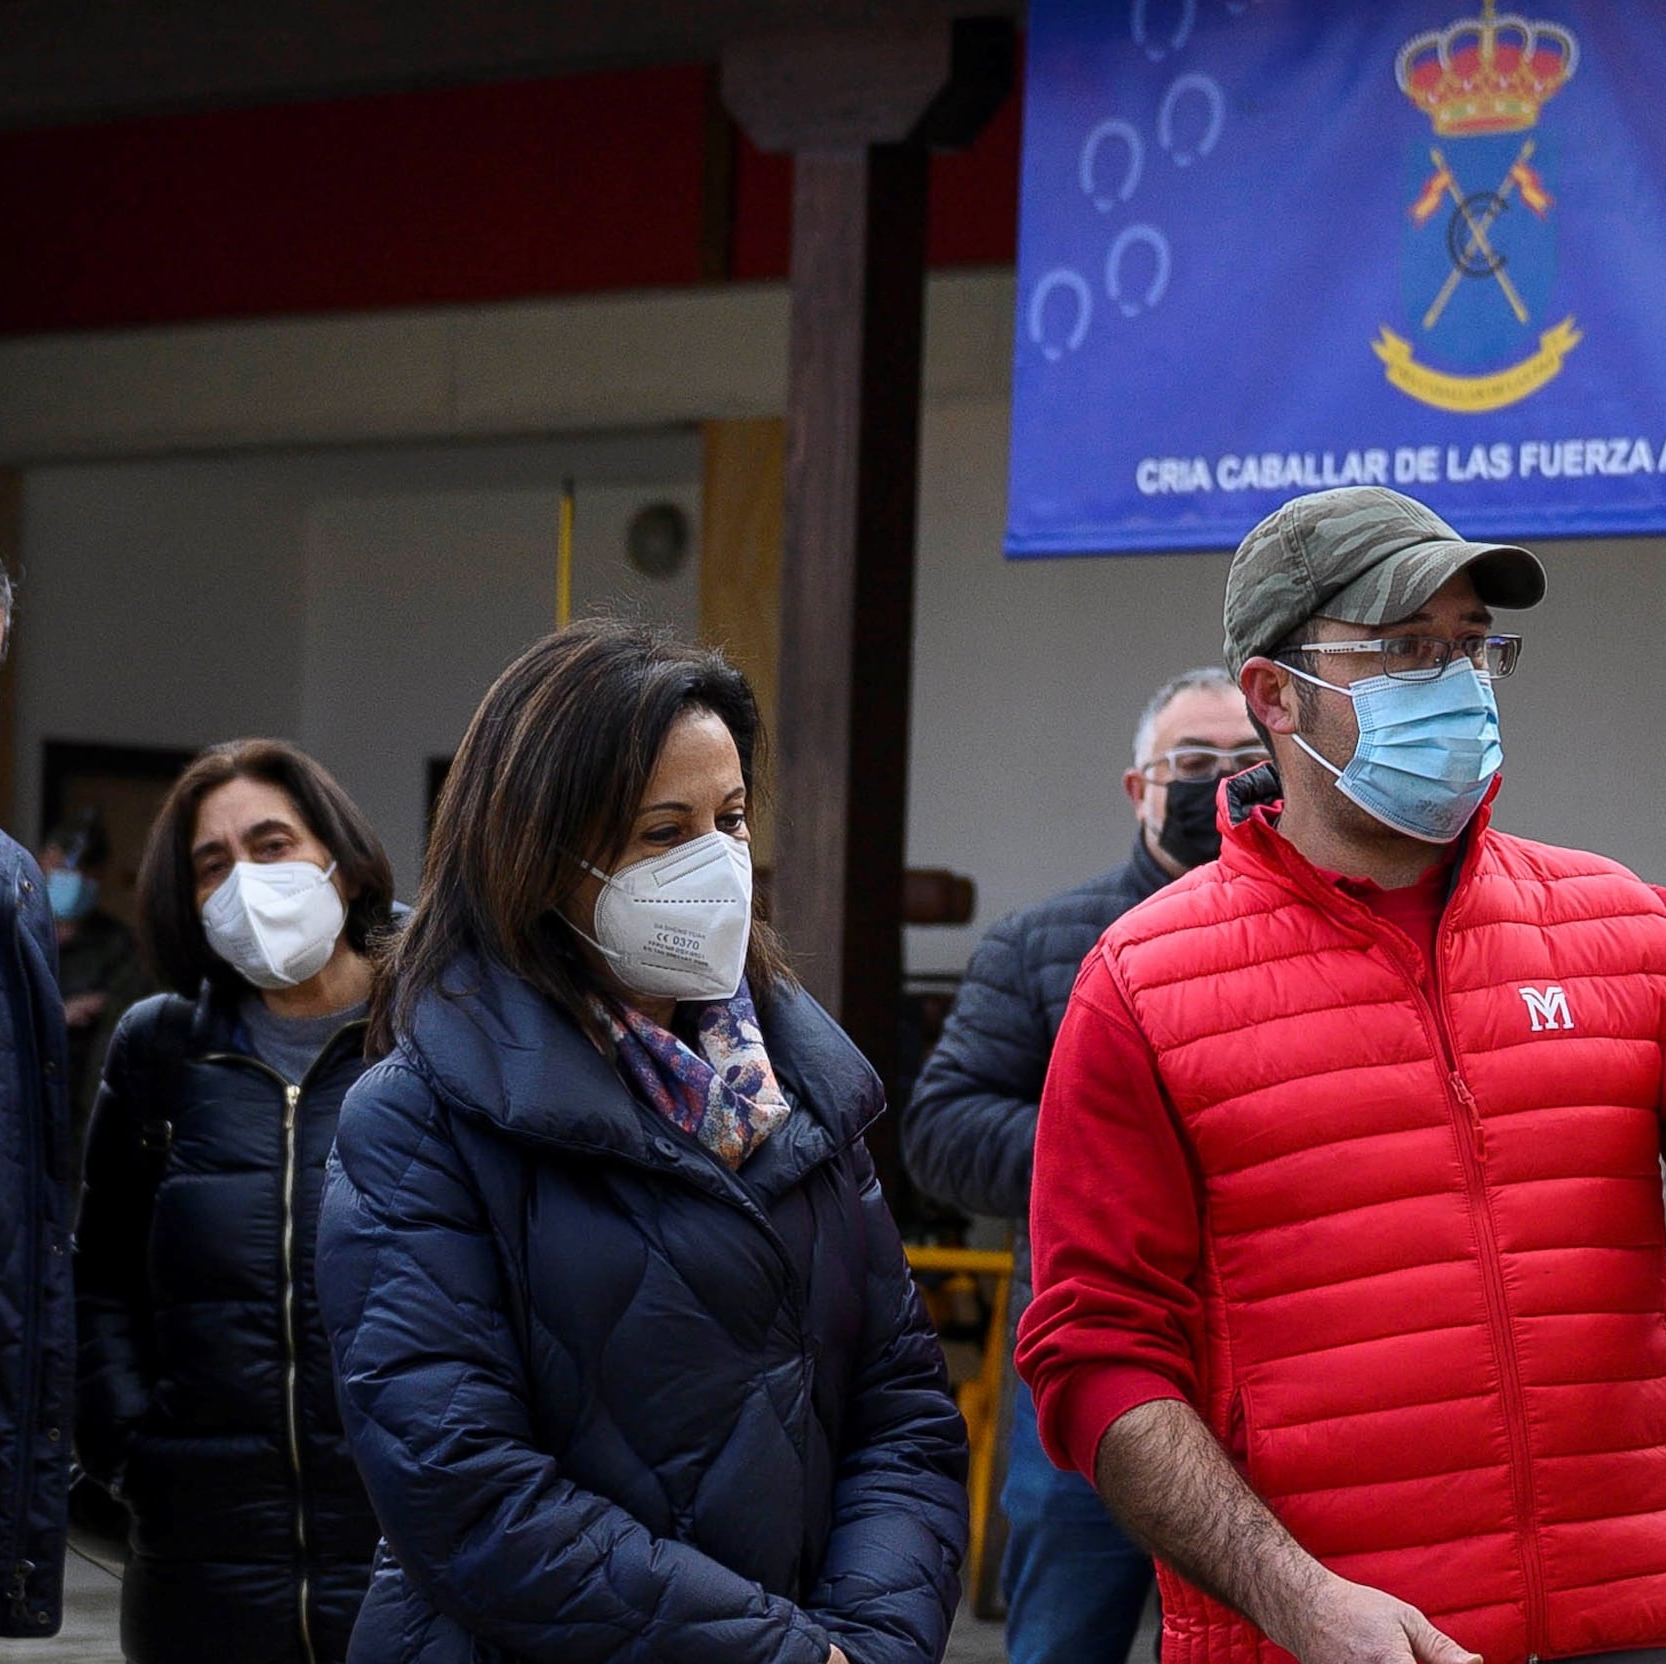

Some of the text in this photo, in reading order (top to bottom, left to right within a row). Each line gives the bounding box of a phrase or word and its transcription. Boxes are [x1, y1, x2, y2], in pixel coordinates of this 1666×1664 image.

[1136, 457, 1212, 494] CRIA
[1216, 450, 1389, 489] CABALLAR
[1394, 446, 1440, 484] DE
[1446, 441, 1512, 481] LAS
[1520, 438, 1653, 478] FUERZA
[673, 935, 700, 950] 0370
